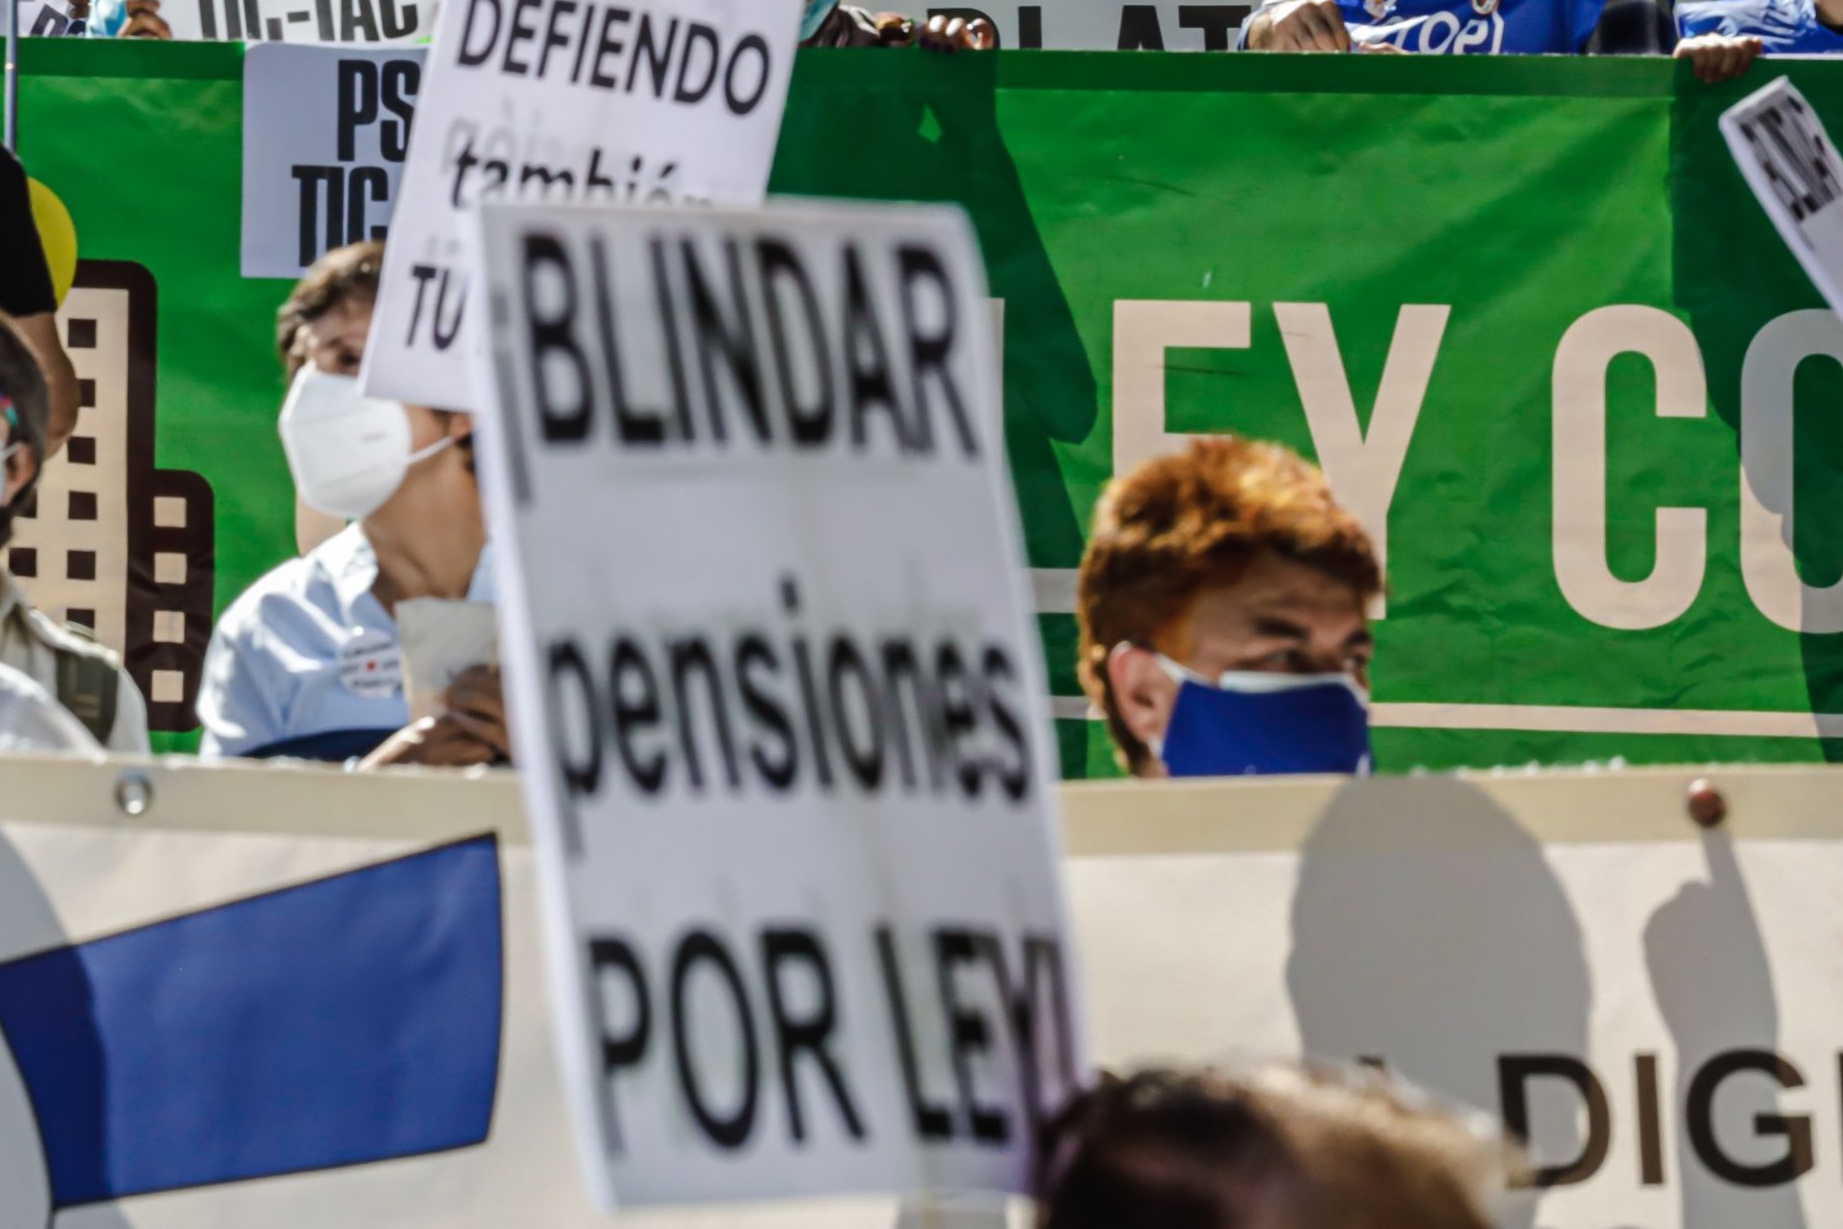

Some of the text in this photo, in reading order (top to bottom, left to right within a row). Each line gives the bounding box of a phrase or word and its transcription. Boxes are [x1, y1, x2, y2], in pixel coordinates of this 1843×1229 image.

[408, 263, 465, 349] TU
[520, 231, 978, 461] BLINDAR
[548, 574, 1032, 831] pensiones
[582, 918, 864, 1160] POR
[1496, 1047, 1843, 1190] DIG
